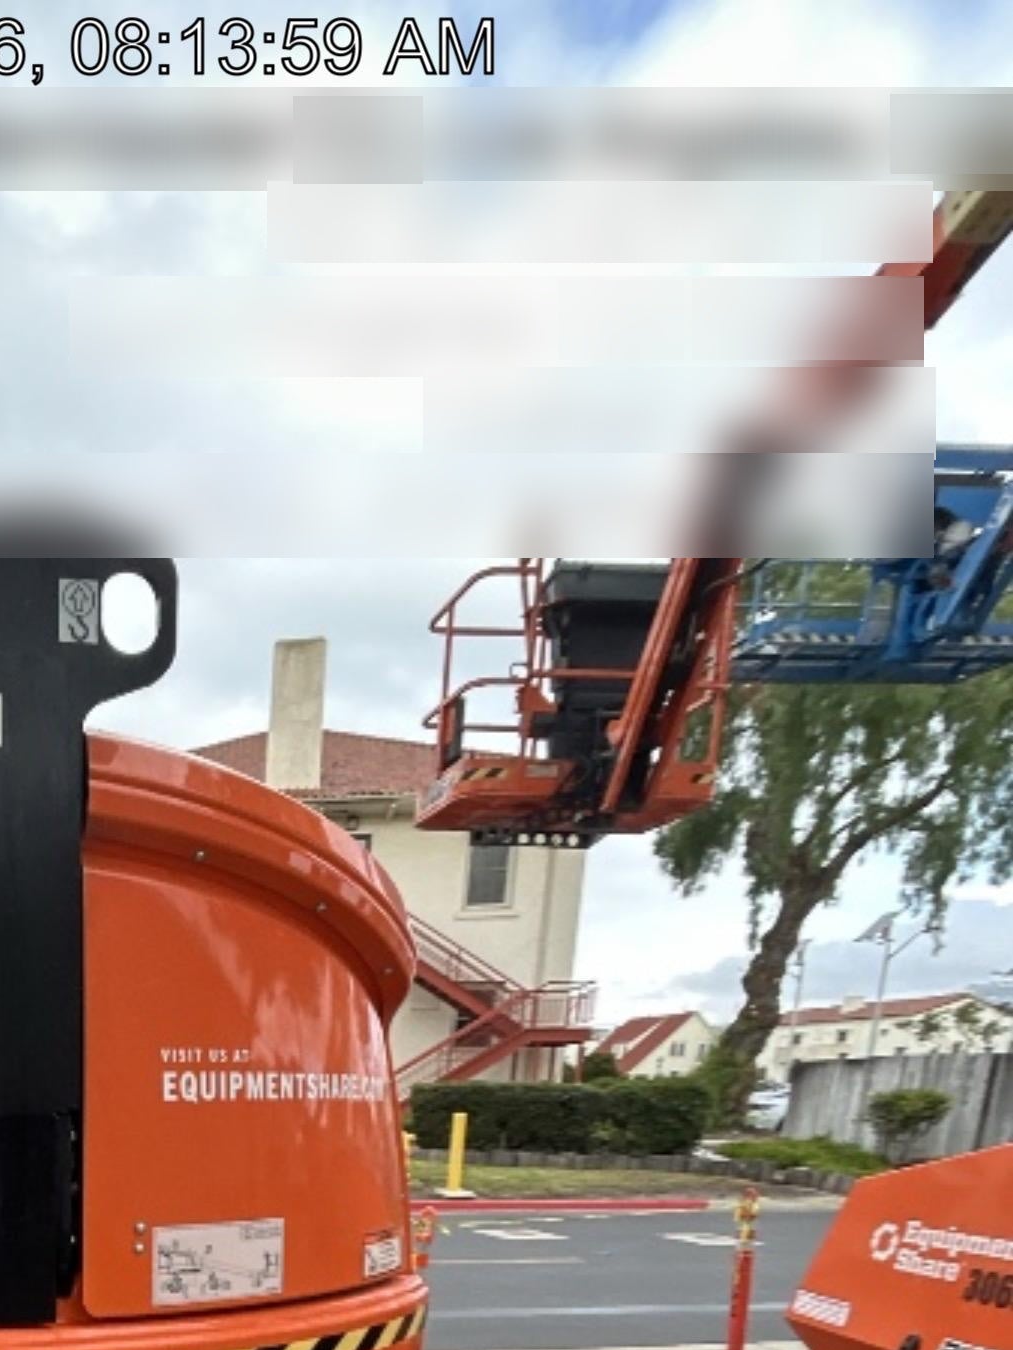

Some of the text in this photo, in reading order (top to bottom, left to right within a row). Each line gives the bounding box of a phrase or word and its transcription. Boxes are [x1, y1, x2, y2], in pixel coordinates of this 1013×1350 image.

[161, 1049, 250, 1063] VISIT US AT
[893, 1249, 961, 1282] Share
